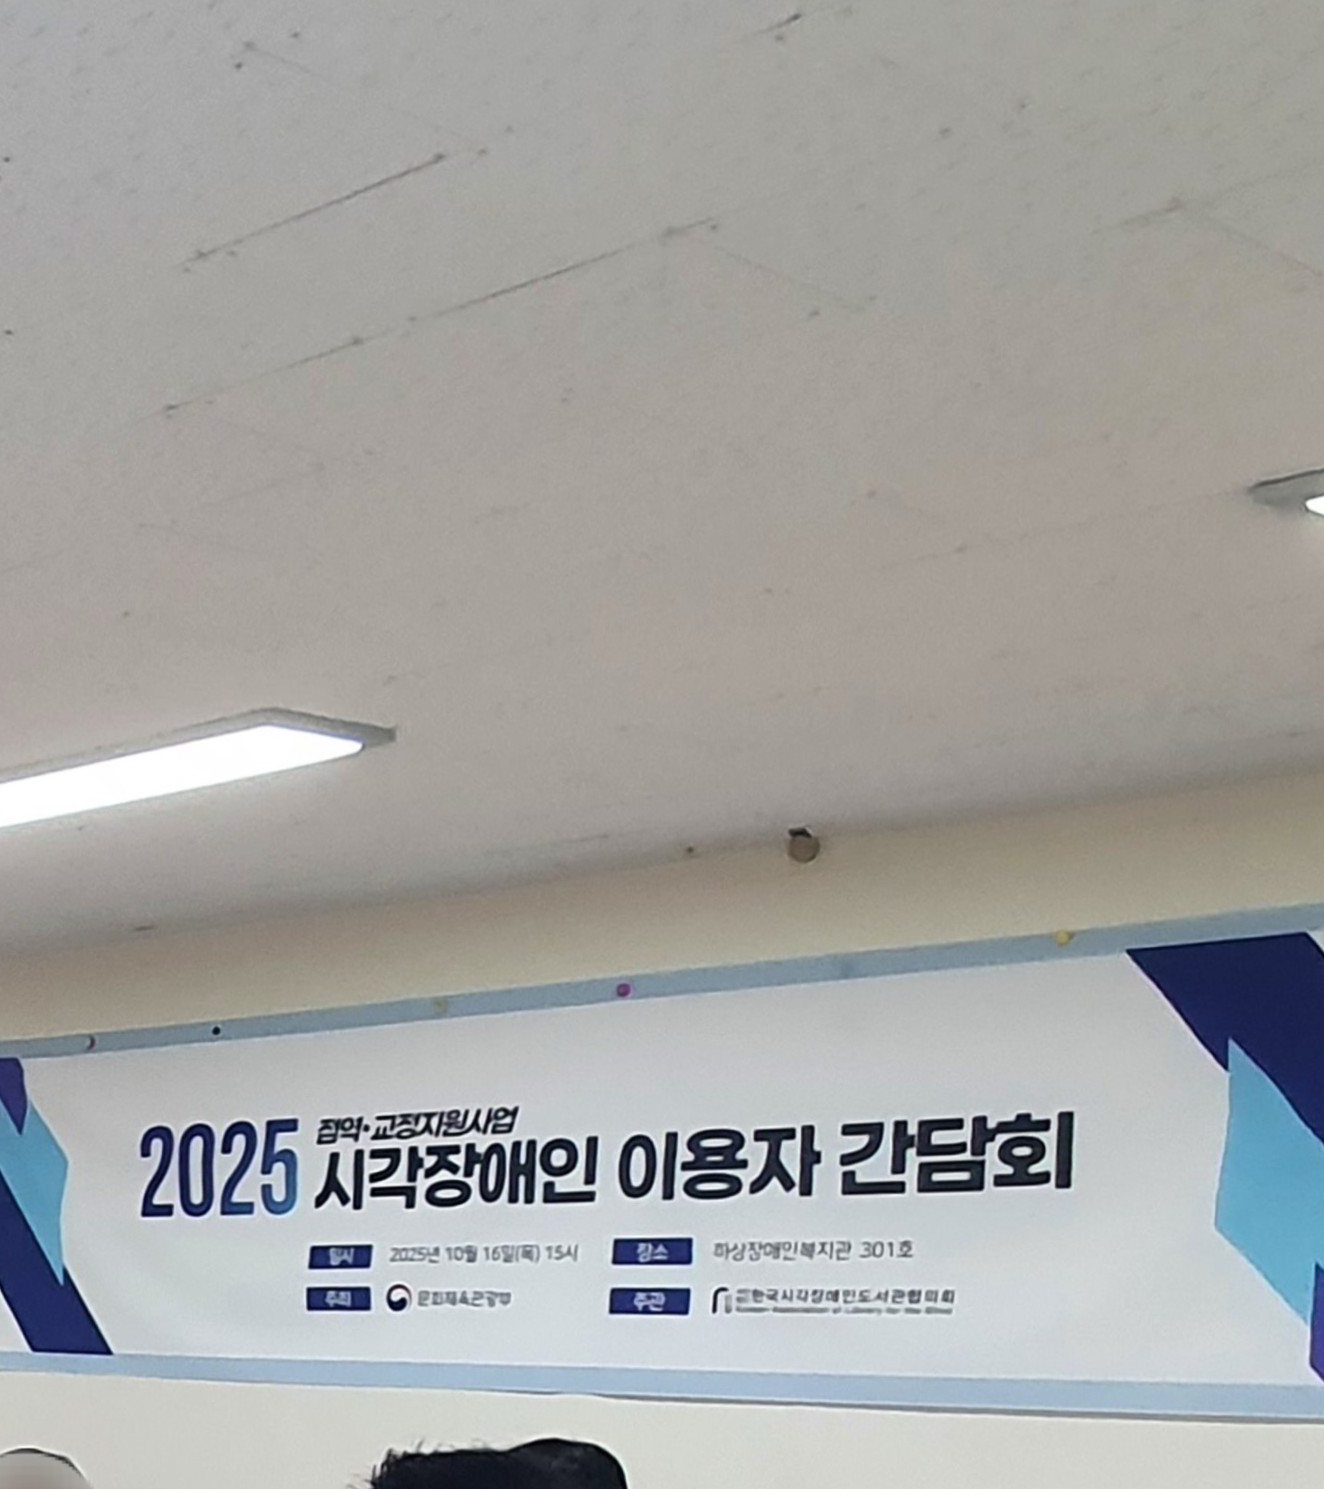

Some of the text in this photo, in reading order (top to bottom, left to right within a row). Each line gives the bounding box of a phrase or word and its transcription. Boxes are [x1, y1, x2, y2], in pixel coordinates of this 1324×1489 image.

[139, 1110, 1076, 1218] 2025 시각장애인 이용자 간담회
[389, 1247, 440, 1264] 2025년
[446, 1245, 478, 1263] 10월
[545, 1243, 579, 1262] 15시
[636, 1243, 669, 1262] 장소
[713, 1239, 915, 1262] 하상장애인복지관 301호
[633, 1291, 666, 1312] 주관
